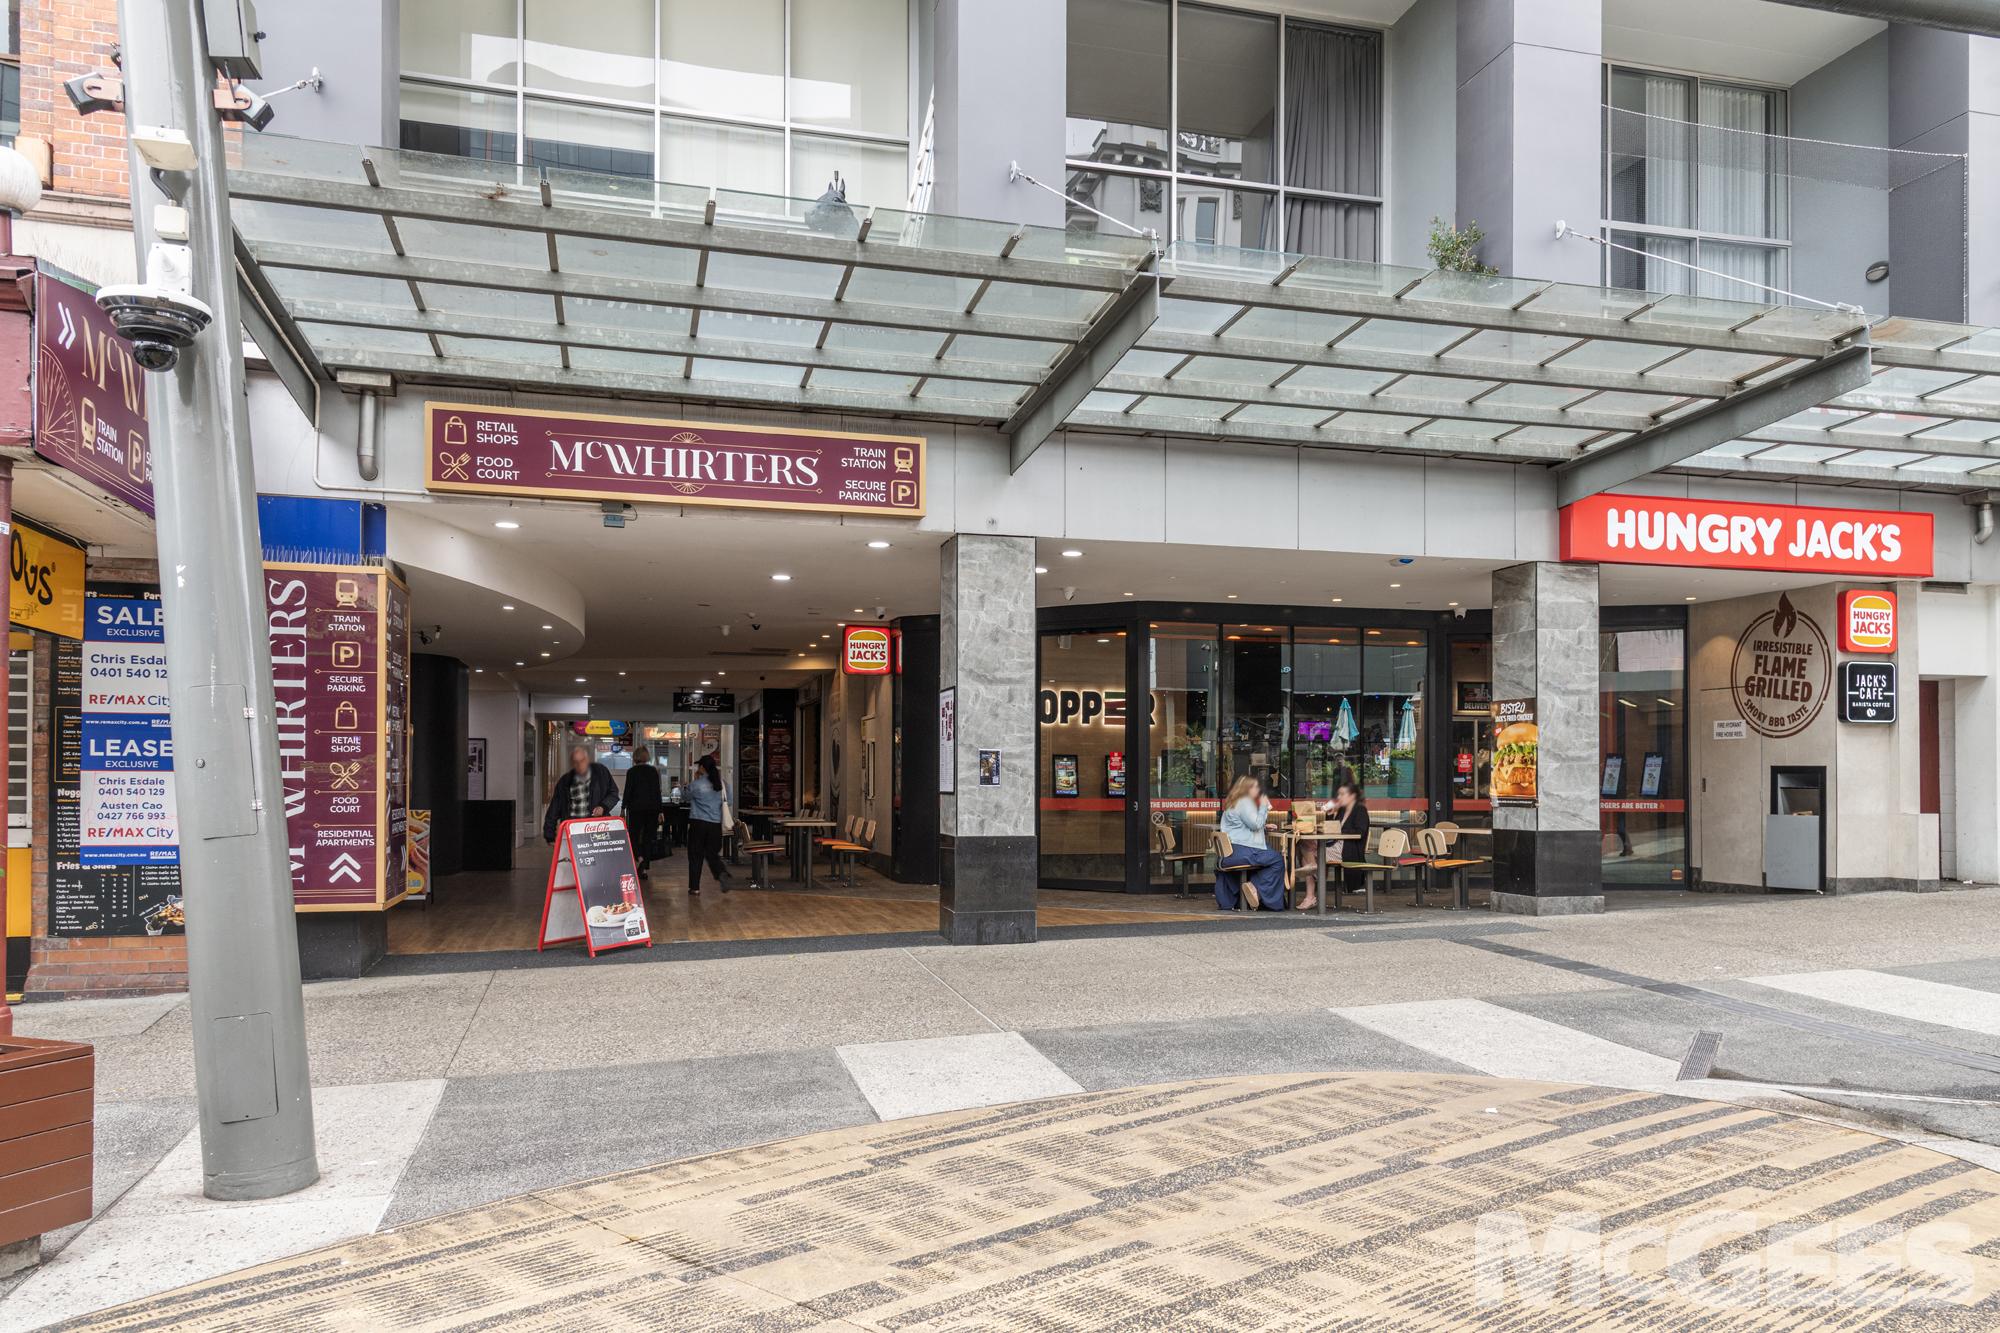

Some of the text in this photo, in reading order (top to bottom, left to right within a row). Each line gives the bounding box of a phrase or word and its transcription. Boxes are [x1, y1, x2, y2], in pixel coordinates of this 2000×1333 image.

[98, 418, 117, 443] TRAIN
[476, 421, 517, 433] RETAIL
[476, 434, 519, 446] SHOPS
[97, 439, 124, 465] STATION
[854, 448, 886, 458] TRAIN
[477, 457, 513, 468] FOOD
[842, 458, 886, 469] STATION
[477, 469, 520, 481] COURT
[846, 480, 886, 491] SECURE
[839, 491, 886, 502] PARKING
[1608, 508, 1901, 562] HUNGRY JACK'S
[98, 606, 164, 626] SALE
[1854, 611, 1891, 620] HUNGRY
[107, 629, 160, 637] EXCLUSIVE
[328, 624, 365, 632] STATION
[1854, 622, 1890, 634] JACK'S
[1753, 640, 1813, 655] IRRESISTIBLE
[91, 654, 167, 665] Chris Esdal
[850, 651, 886, 661] JACK'S
[1754, 655, 1807, 679] FLAME
[91, 668, 122, 677] 0401
[126, 668, 151, 678] 540
[330, 676, 363, 684] SECURE
[1856, 675, 1886, 688] JACK'S
[1745, 676, 1812, 702] GRILLED
[1860, 688, 1883, 700] CAFE
[89, 695, 145, 705] RE/MAX
[1500, 702, 1526, 715] BISTRO
[1744, 699, 1809, 727] SMOKY BBQ TASTE
[332, 737, 360, 745] RETAIL
[90, 739, 173, 757] LEASE
[99, 778, 165, 786] Chris Esdale
[99, 788, 165, 796] 0401 540 129
[101, 802, 163, 810] Austen Cao
[330, 805, 361, 813] COURT
[88, 827, 173, 839] RE/MAX City
[318, 830, 373, 838] RESIDENTIAL
[316, 839, 375, 847] APARTMENTS
[56, 862, 80, 870] Fries
